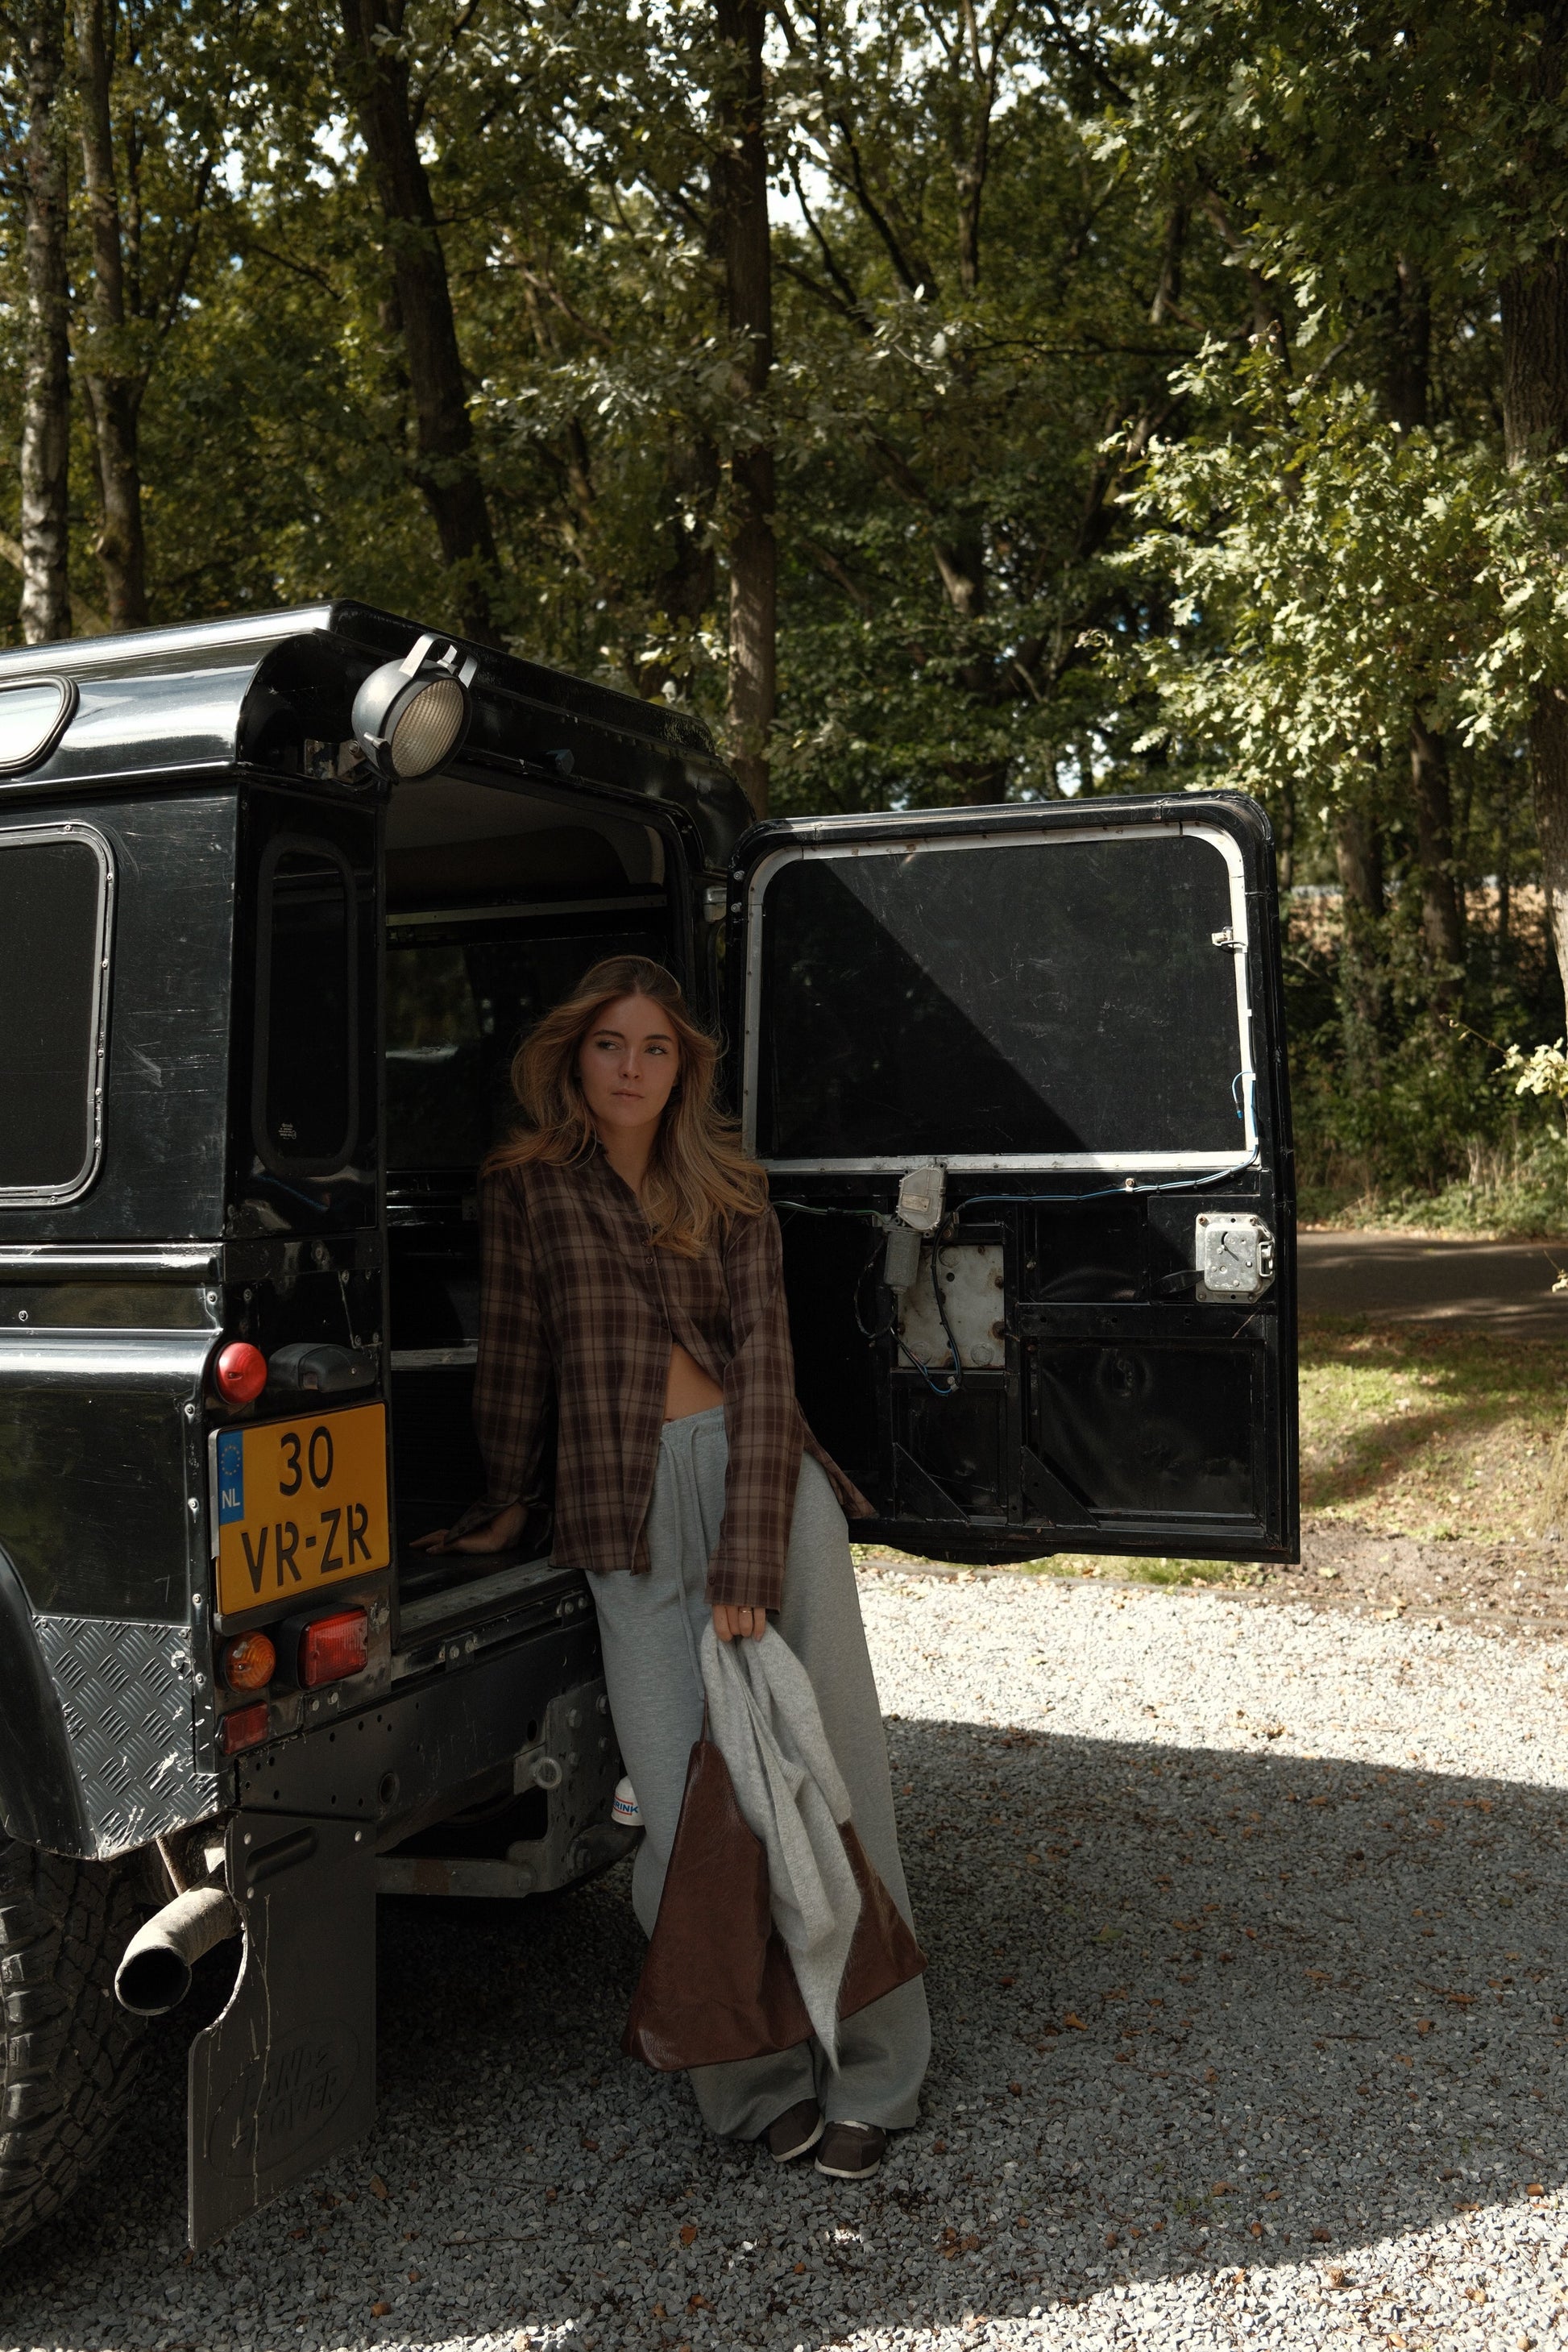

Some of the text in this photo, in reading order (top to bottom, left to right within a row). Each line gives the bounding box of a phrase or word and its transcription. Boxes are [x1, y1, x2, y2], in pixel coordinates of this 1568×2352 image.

[280, 1426, 334, 1496] 30
[222, 1488, 241, 1509] NL
[241, 1503, 372, 1594] VR-ZR
